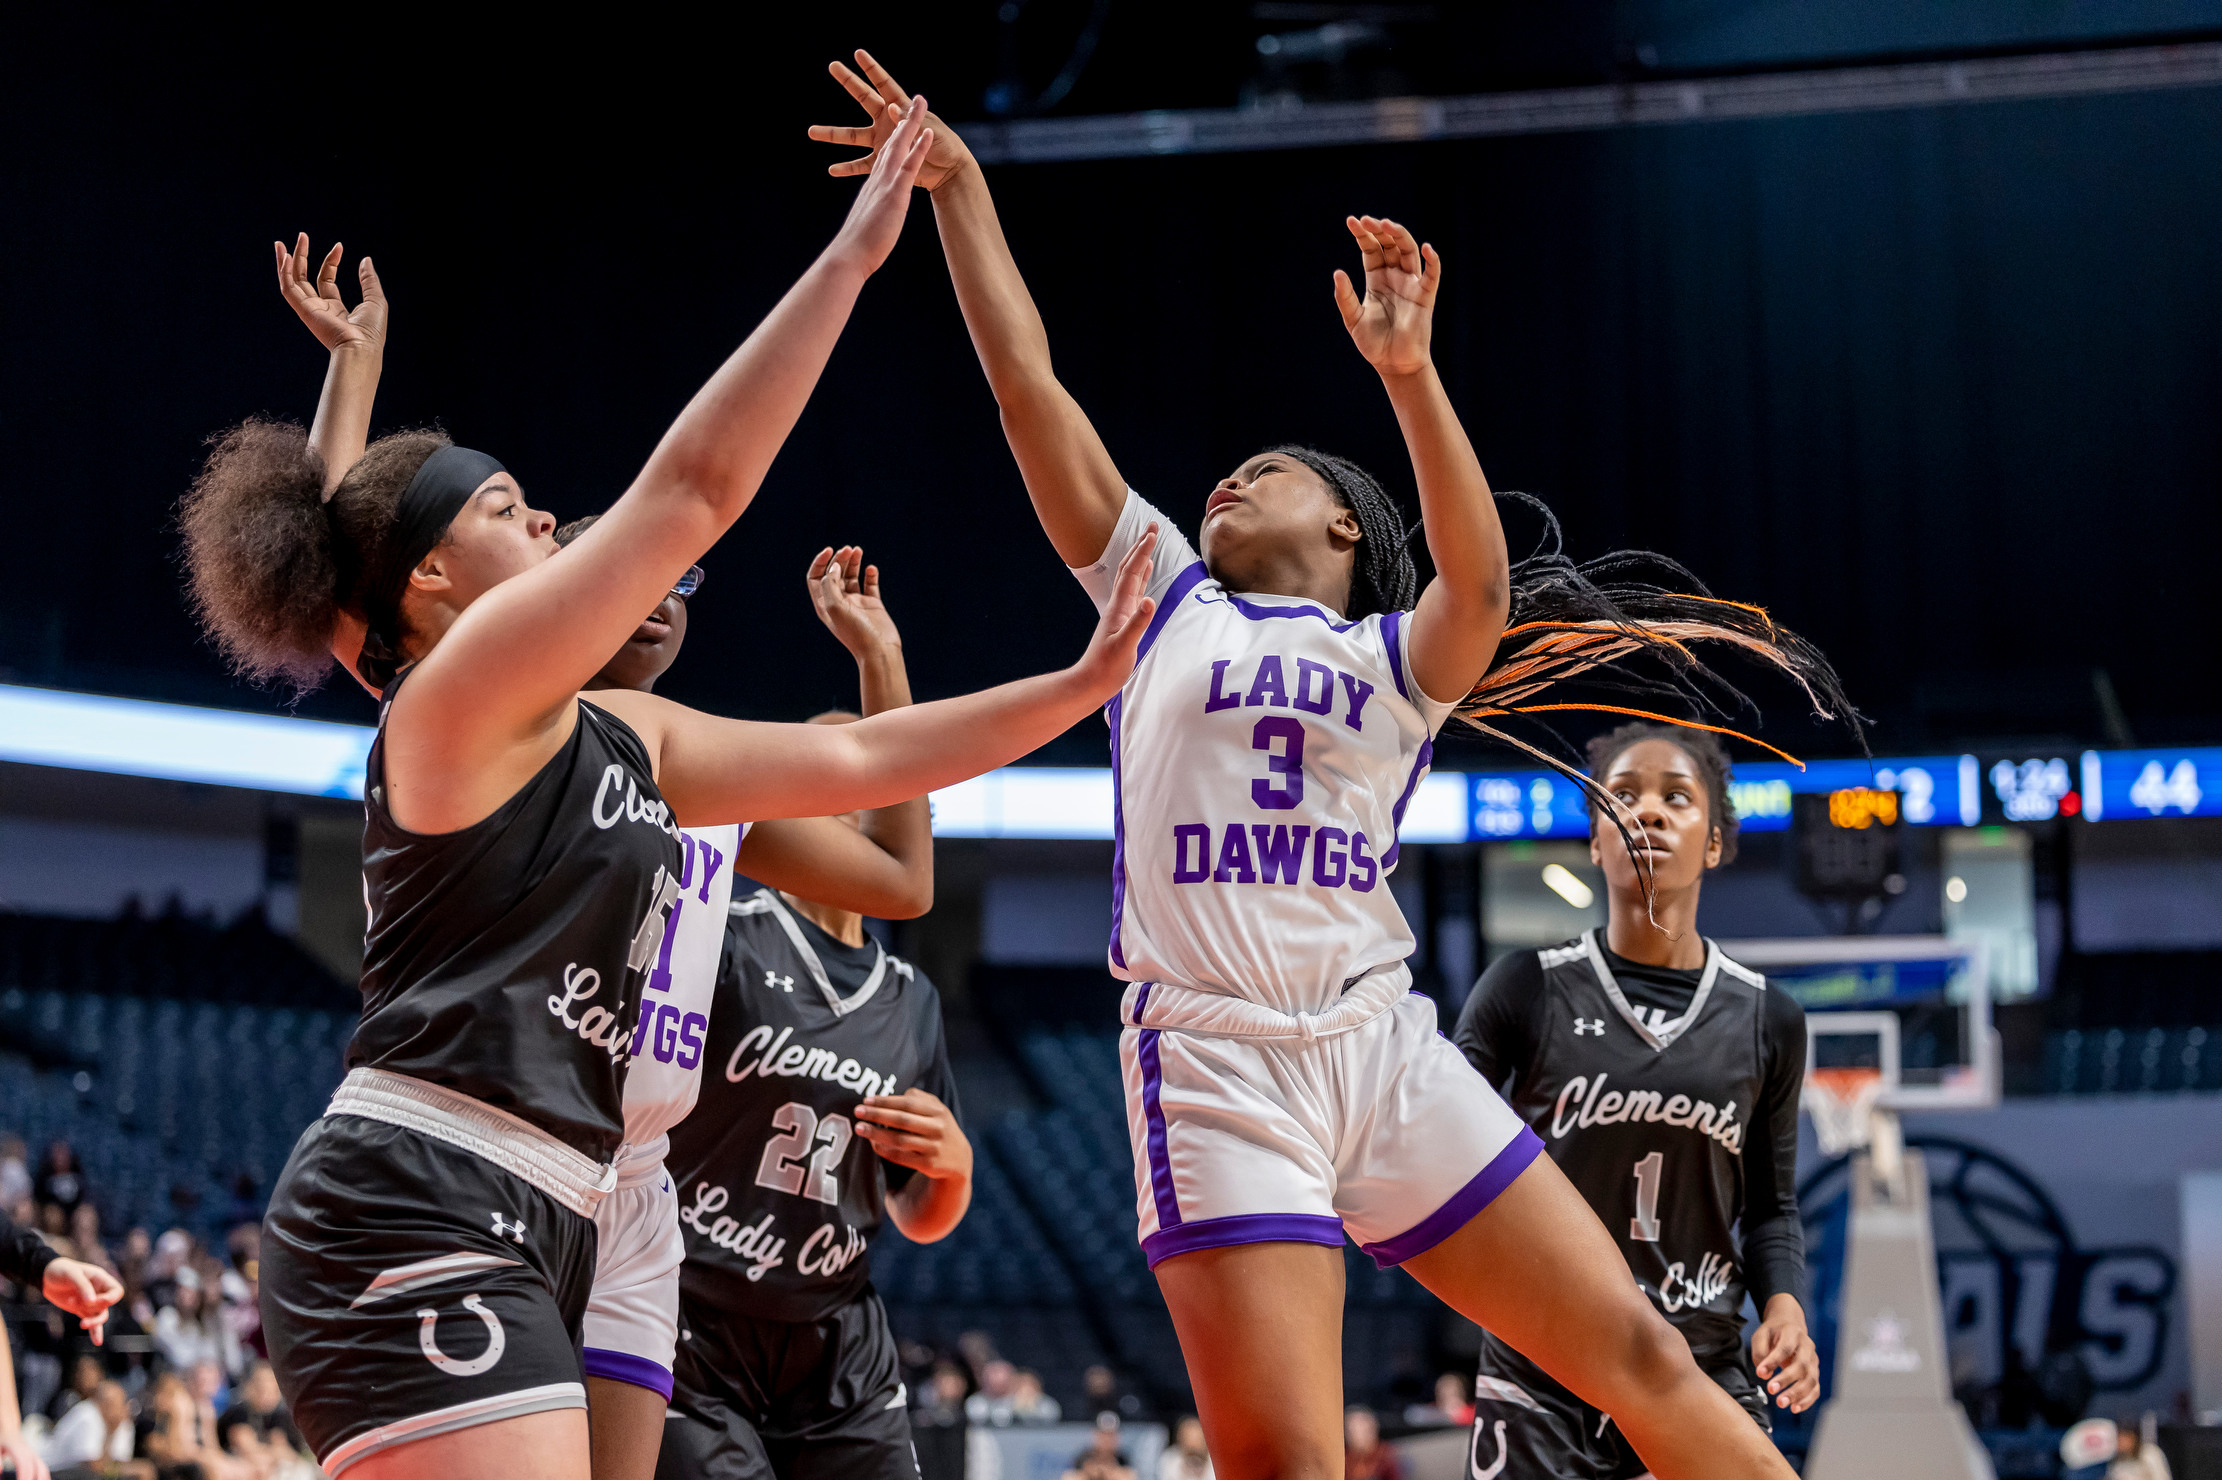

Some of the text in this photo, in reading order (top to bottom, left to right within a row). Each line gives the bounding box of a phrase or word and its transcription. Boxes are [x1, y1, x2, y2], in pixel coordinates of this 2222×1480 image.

[1205, 655, 1374, 732] LADY
[1252, 716, 1305, 810] 3
[1173, 823, 1377, 893] DAWGS
[725, 1025, 898, 1097] Clement
[755, 1102, 853, 1206] 22
[1550, 1072, 1743, 1155] Clements
[680, 1182, 786, 1282] Lady
[1630, 1151, 1664, 1242] 1
